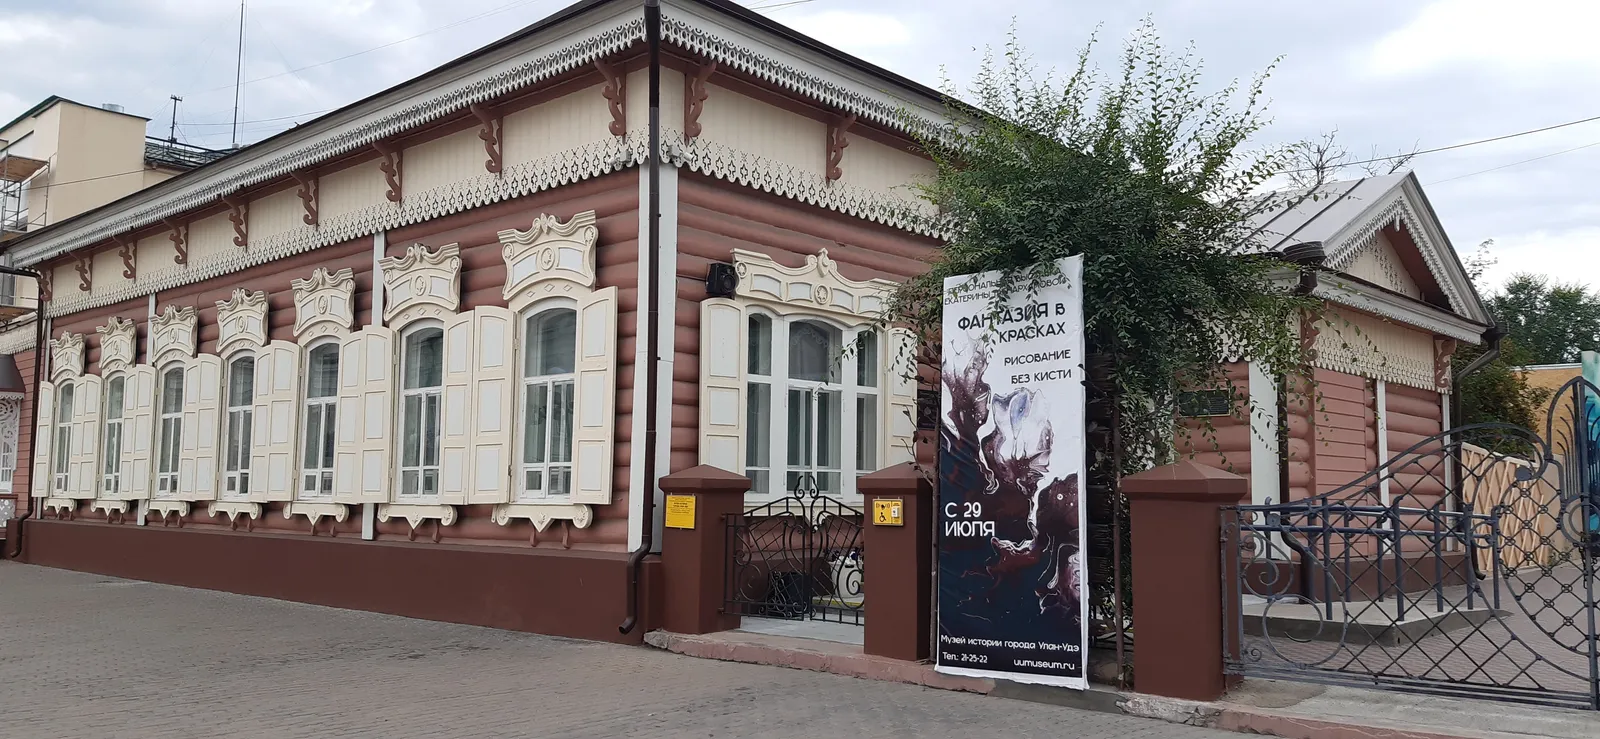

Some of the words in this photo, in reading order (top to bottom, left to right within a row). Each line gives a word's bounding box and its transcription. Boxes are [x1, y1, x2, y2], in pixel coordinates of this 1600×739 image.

[945, 291, 990, 305] ЕКАТЕРИНЫ
[999, 321, 1066, 343] КРАСКАХ
[1004, 349, 1071, 366] РИСОВАНИЕ
[1011, 373, 1030, 385] БЕЗ
[1034, 369, 1072, 382] КИСТИ
[945, 502, 957, 518] С
[963, 502, 982, 518] 29
[945, 521, 995, 537] ИЮЛЯ
[940, 634, 966, 645] Музей
[967, 638, 1003, 648] истории
[1004, 640, 1036, 650] города
[1038, 641, 1080, 652] Улан-Удэ
[1013, 659, 1075, 670] uumuseum.ru
